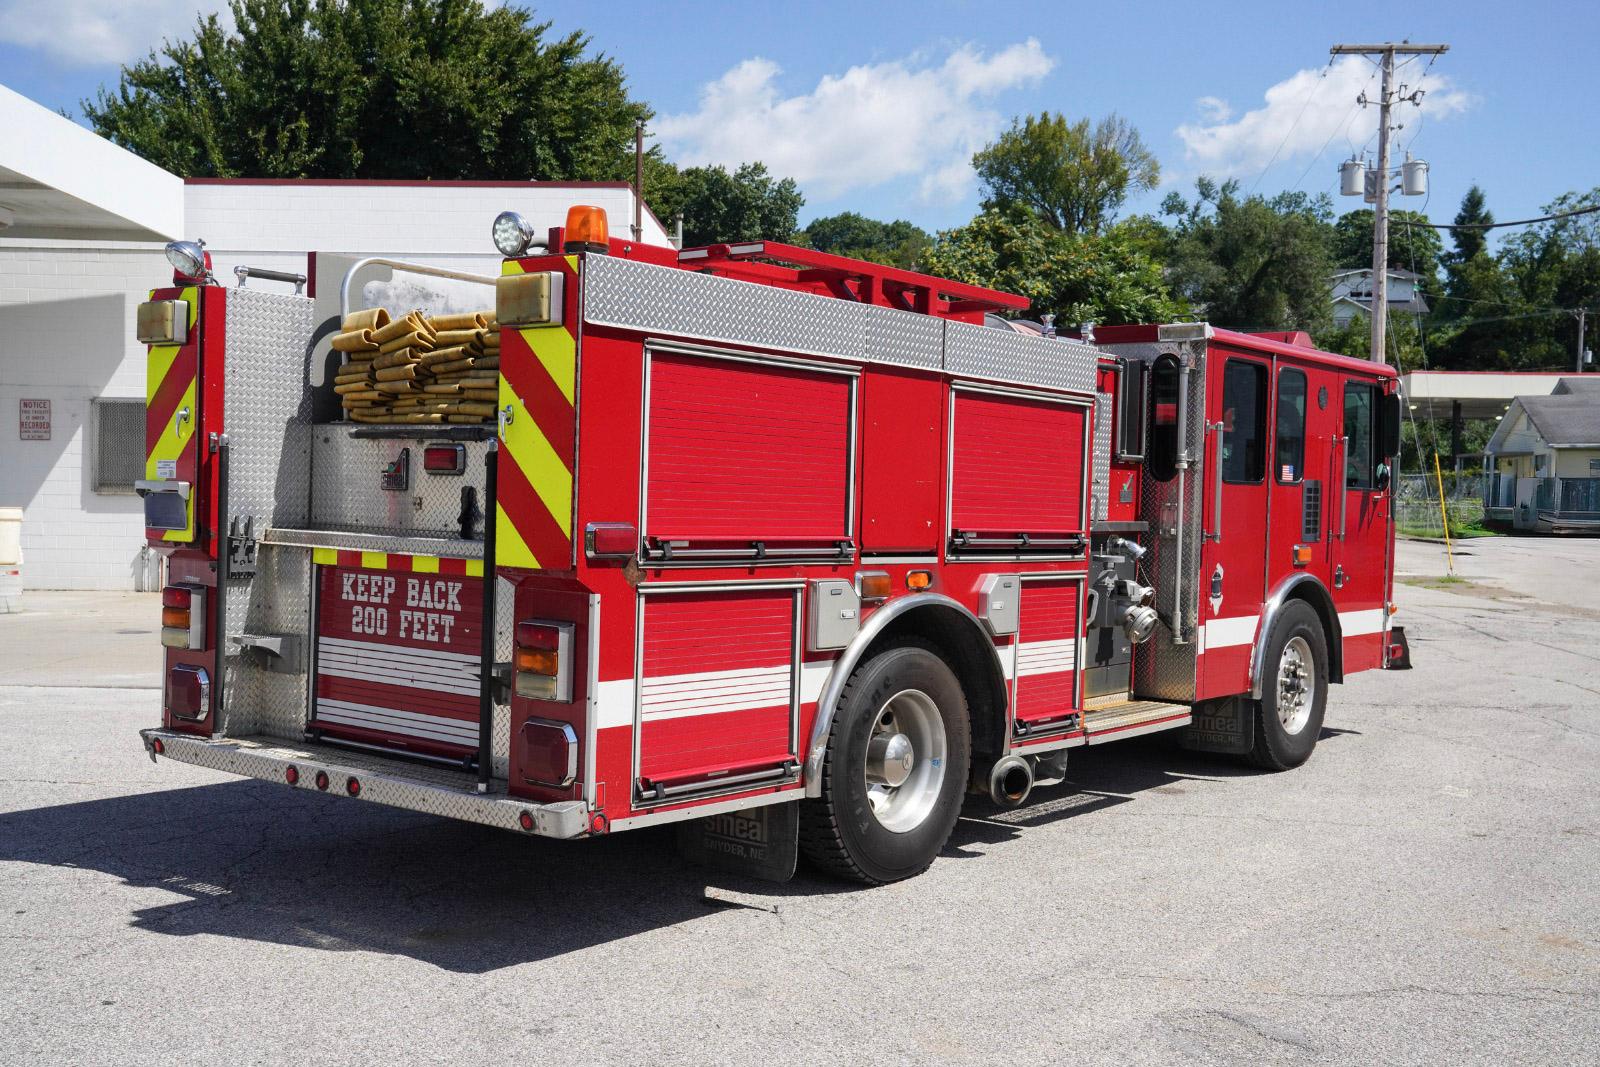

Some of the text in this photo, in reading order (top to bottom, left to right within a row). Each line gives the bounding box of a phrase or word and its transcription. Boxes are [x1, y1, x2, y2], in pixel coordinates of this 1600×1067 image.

[341, 572, 463, 612] KEEP BACK
[351, 605, 455, 643] 200 FEET
